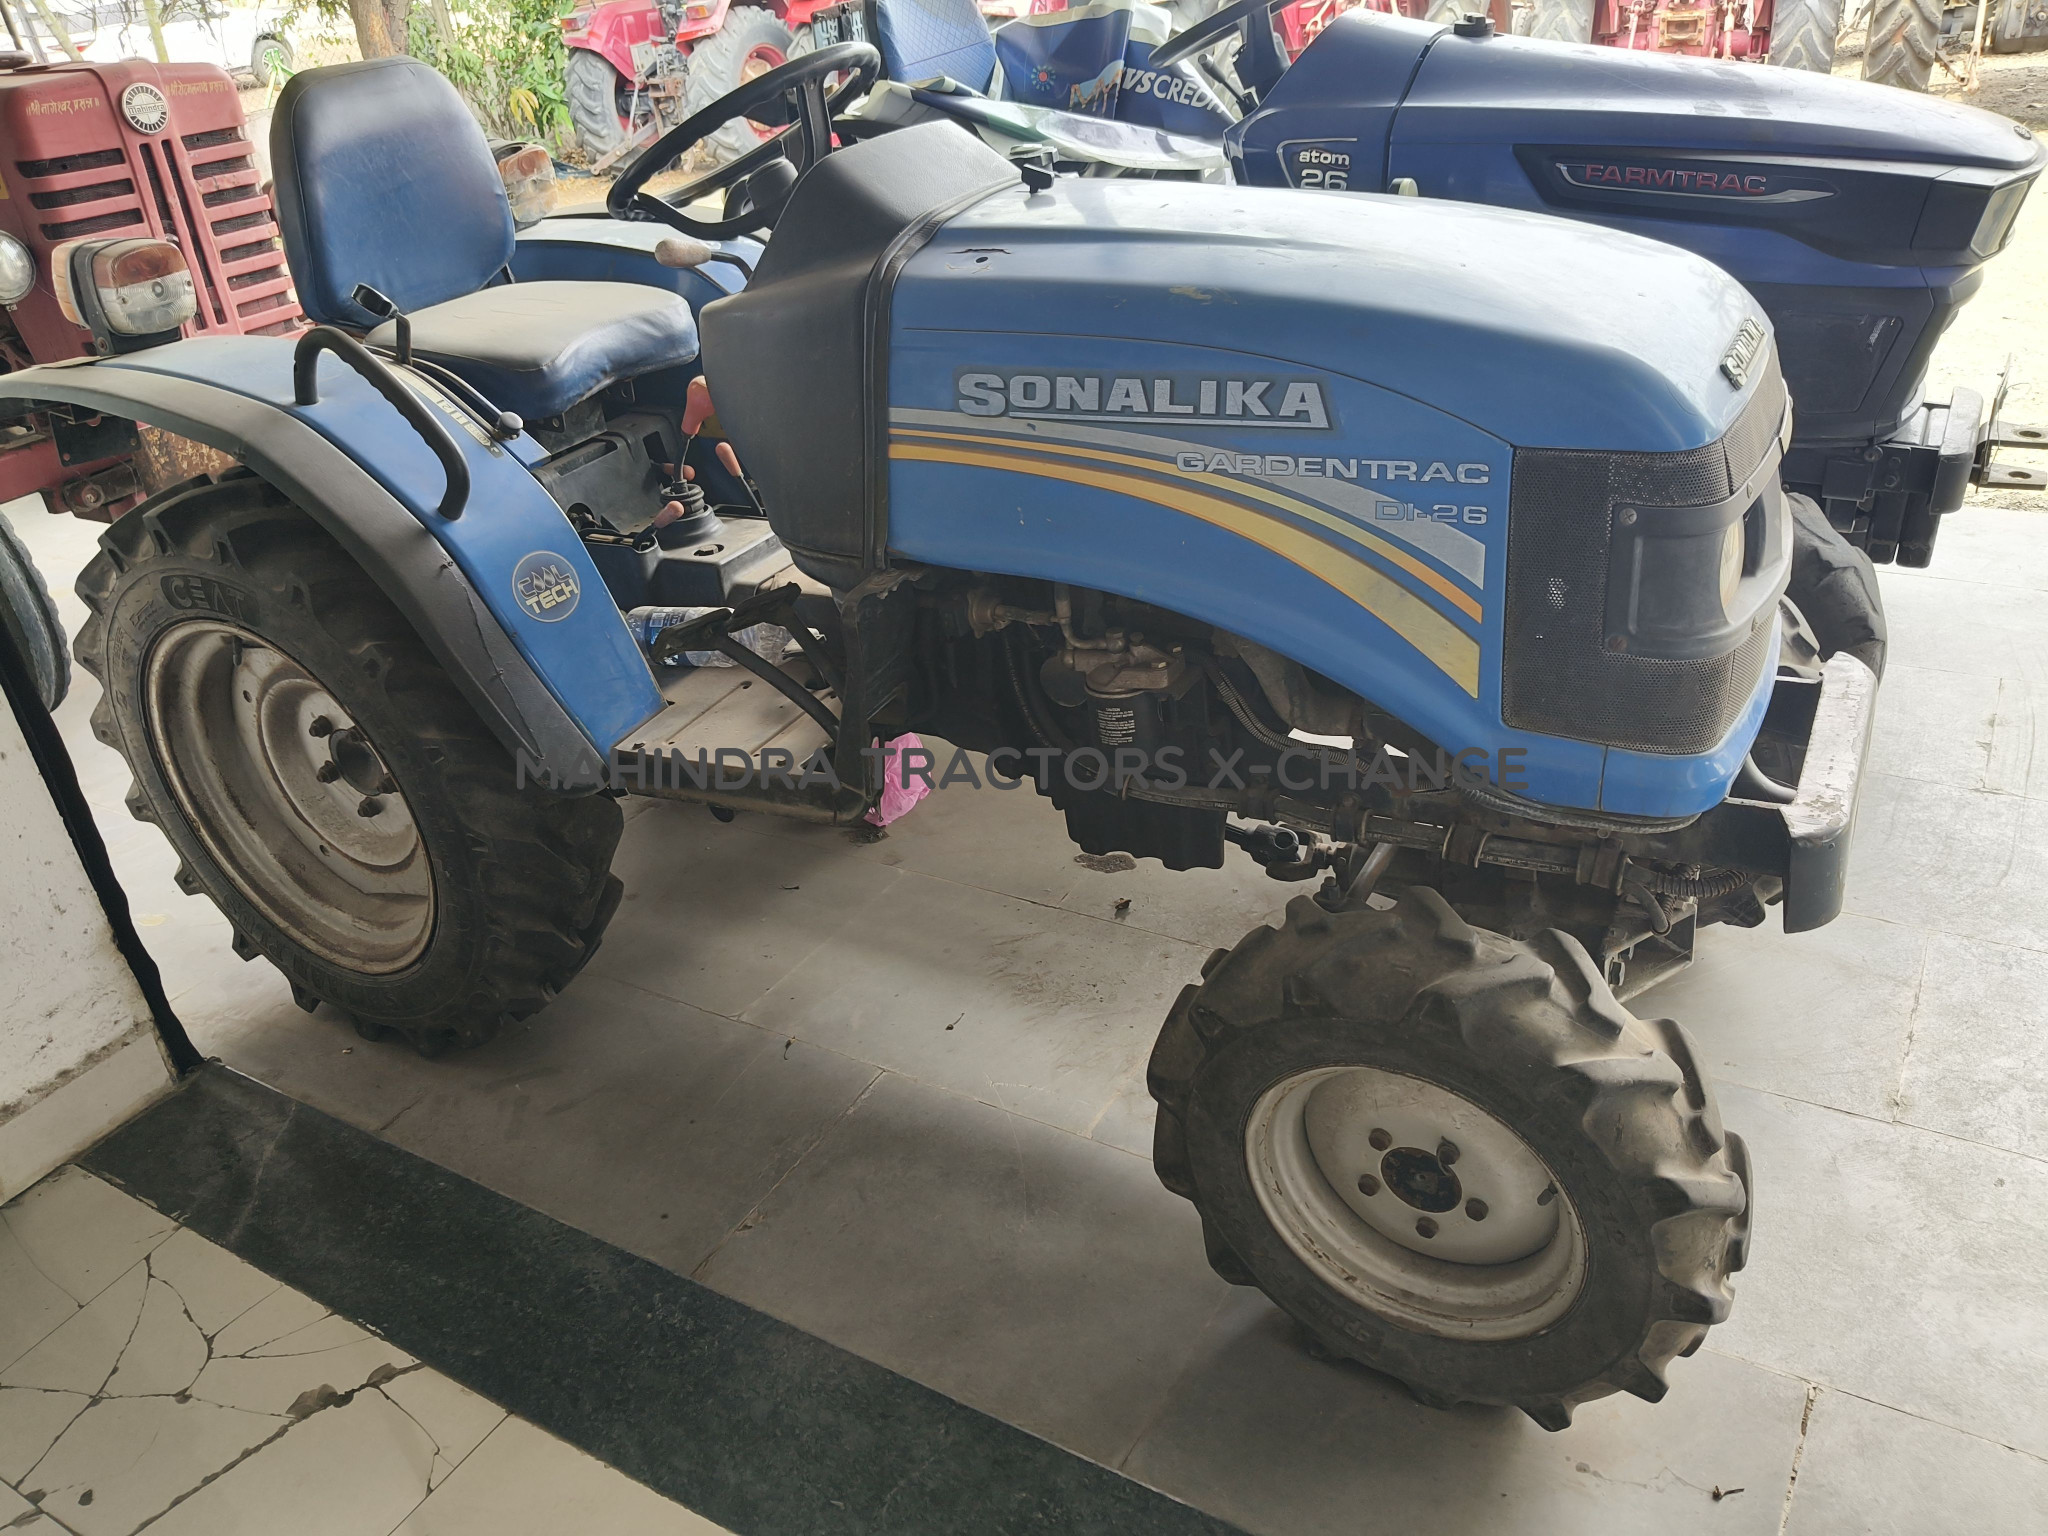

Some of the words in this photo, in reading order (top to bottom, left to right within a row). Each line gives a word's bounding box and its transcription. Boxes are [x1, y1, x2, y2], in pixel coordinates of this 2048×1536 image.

[127, 103, 165, 115] Mahindra
[1299, 150, 1350, 165] atom
[1301, 168, 1348, 191] 26
[1585, 164, 1767, 195] FARMTRAC
[958, 373, 1330, 429] SONALIKA
[1176, 452, 1490, 484] GARDENTRAC
[1375, 501, 1488, 525] DI-26
[171, 577, 245, 620] CEAT
[525, 578, 579, 614] TECH
